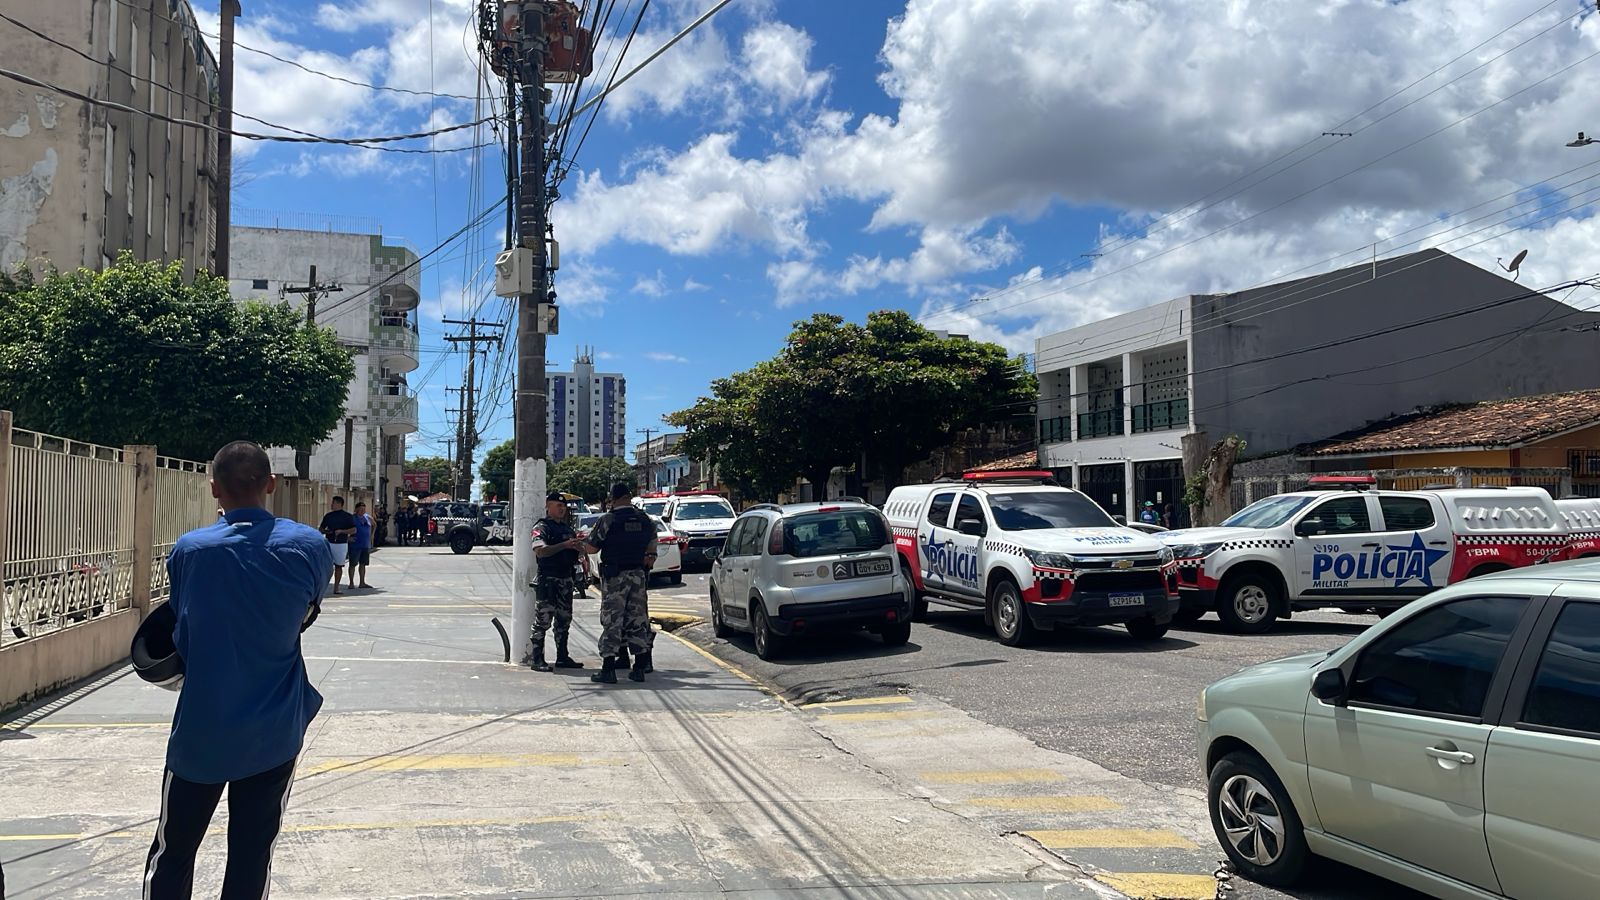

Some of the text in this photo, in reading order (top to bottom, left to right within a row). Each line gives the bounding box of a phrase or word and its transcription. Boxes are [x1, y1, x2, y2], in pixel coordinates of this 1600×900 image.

[1323, 545, 1340, 553] 190
[929, 545, 978, 583] POLÍCIA
[1312, 546, 1425, 580] POLÍCIA
[1312, 580, 1349, 588] MILITAR
